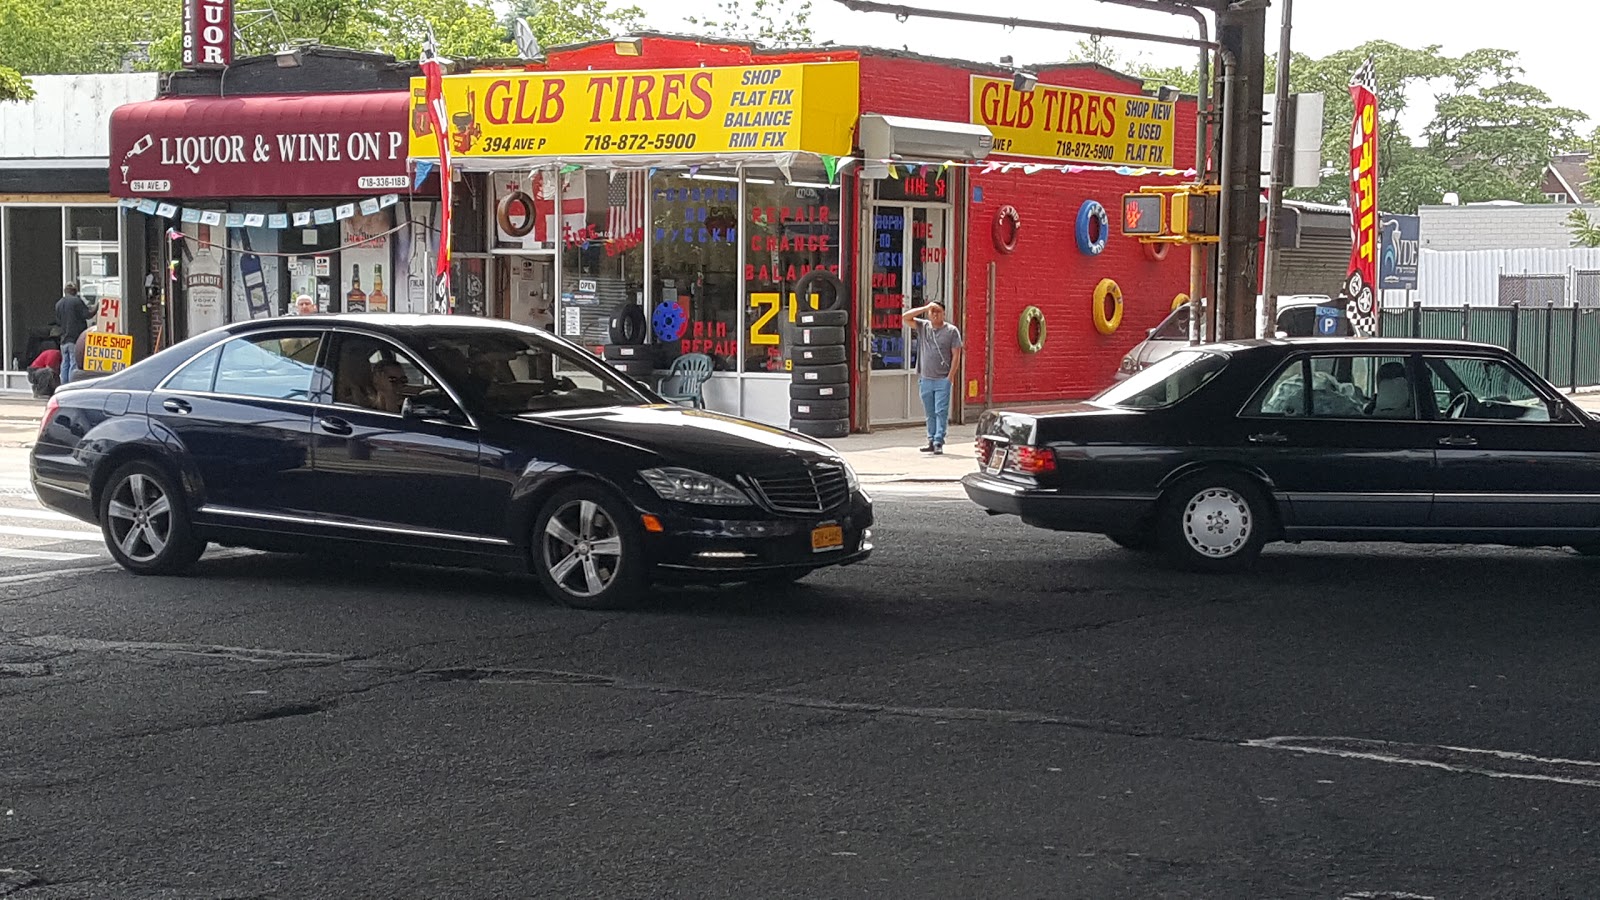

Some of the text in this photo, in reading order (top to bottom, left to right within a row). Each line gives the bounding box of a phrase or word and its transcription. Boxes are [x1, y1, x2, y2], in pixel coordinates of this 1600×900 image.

[184, 0, 192, 63] 1188
[203, 0, 223, 63] UOR
[741, 69, 781, 86] SHOP
[483, 78, 566, 125] GLB
[586, 72, 713, 122] TIRES
[730, 89, 794, 107] FLAT FIX
[980, 81, 1116, 138] GLB TIRES
[1125, 100, 1172, 121] SHOP NEW
[723, 111, 793, 128] BALANCE
[728, 131, 788, 148] RIM FIX
[1127, 124, 1161, 141] & USED
[482, 137, 546, 152] 394 AVE P
[583, 133, 697, 151] 718-872-5900
[992, 138, 1013, 151] AVE P
[1056, 140, 1114, 161] 718-872-5900
[160, 131, 403, 174] LIQUOR & WINE ON P
[1125, 143, 1164, 163] FLAT FIX
[163, 181, 168, 190] P
[1360, 104, 1374, 264] TIRES
[752, 205, 830, 223] REPAIR
[751, 234, 830, 252] CHANGE
[581, 282, 595, 290] OPEN
[101, 299, 119, 318] 24
[693, 321, 727, 337] RIM
[88, 335, 131, 349] TIRE SHOP
[681, 340, 737, 356] REPAIR
[87, 346, 122, 360] BENDED
[88, 359, 103, 371] FIX
